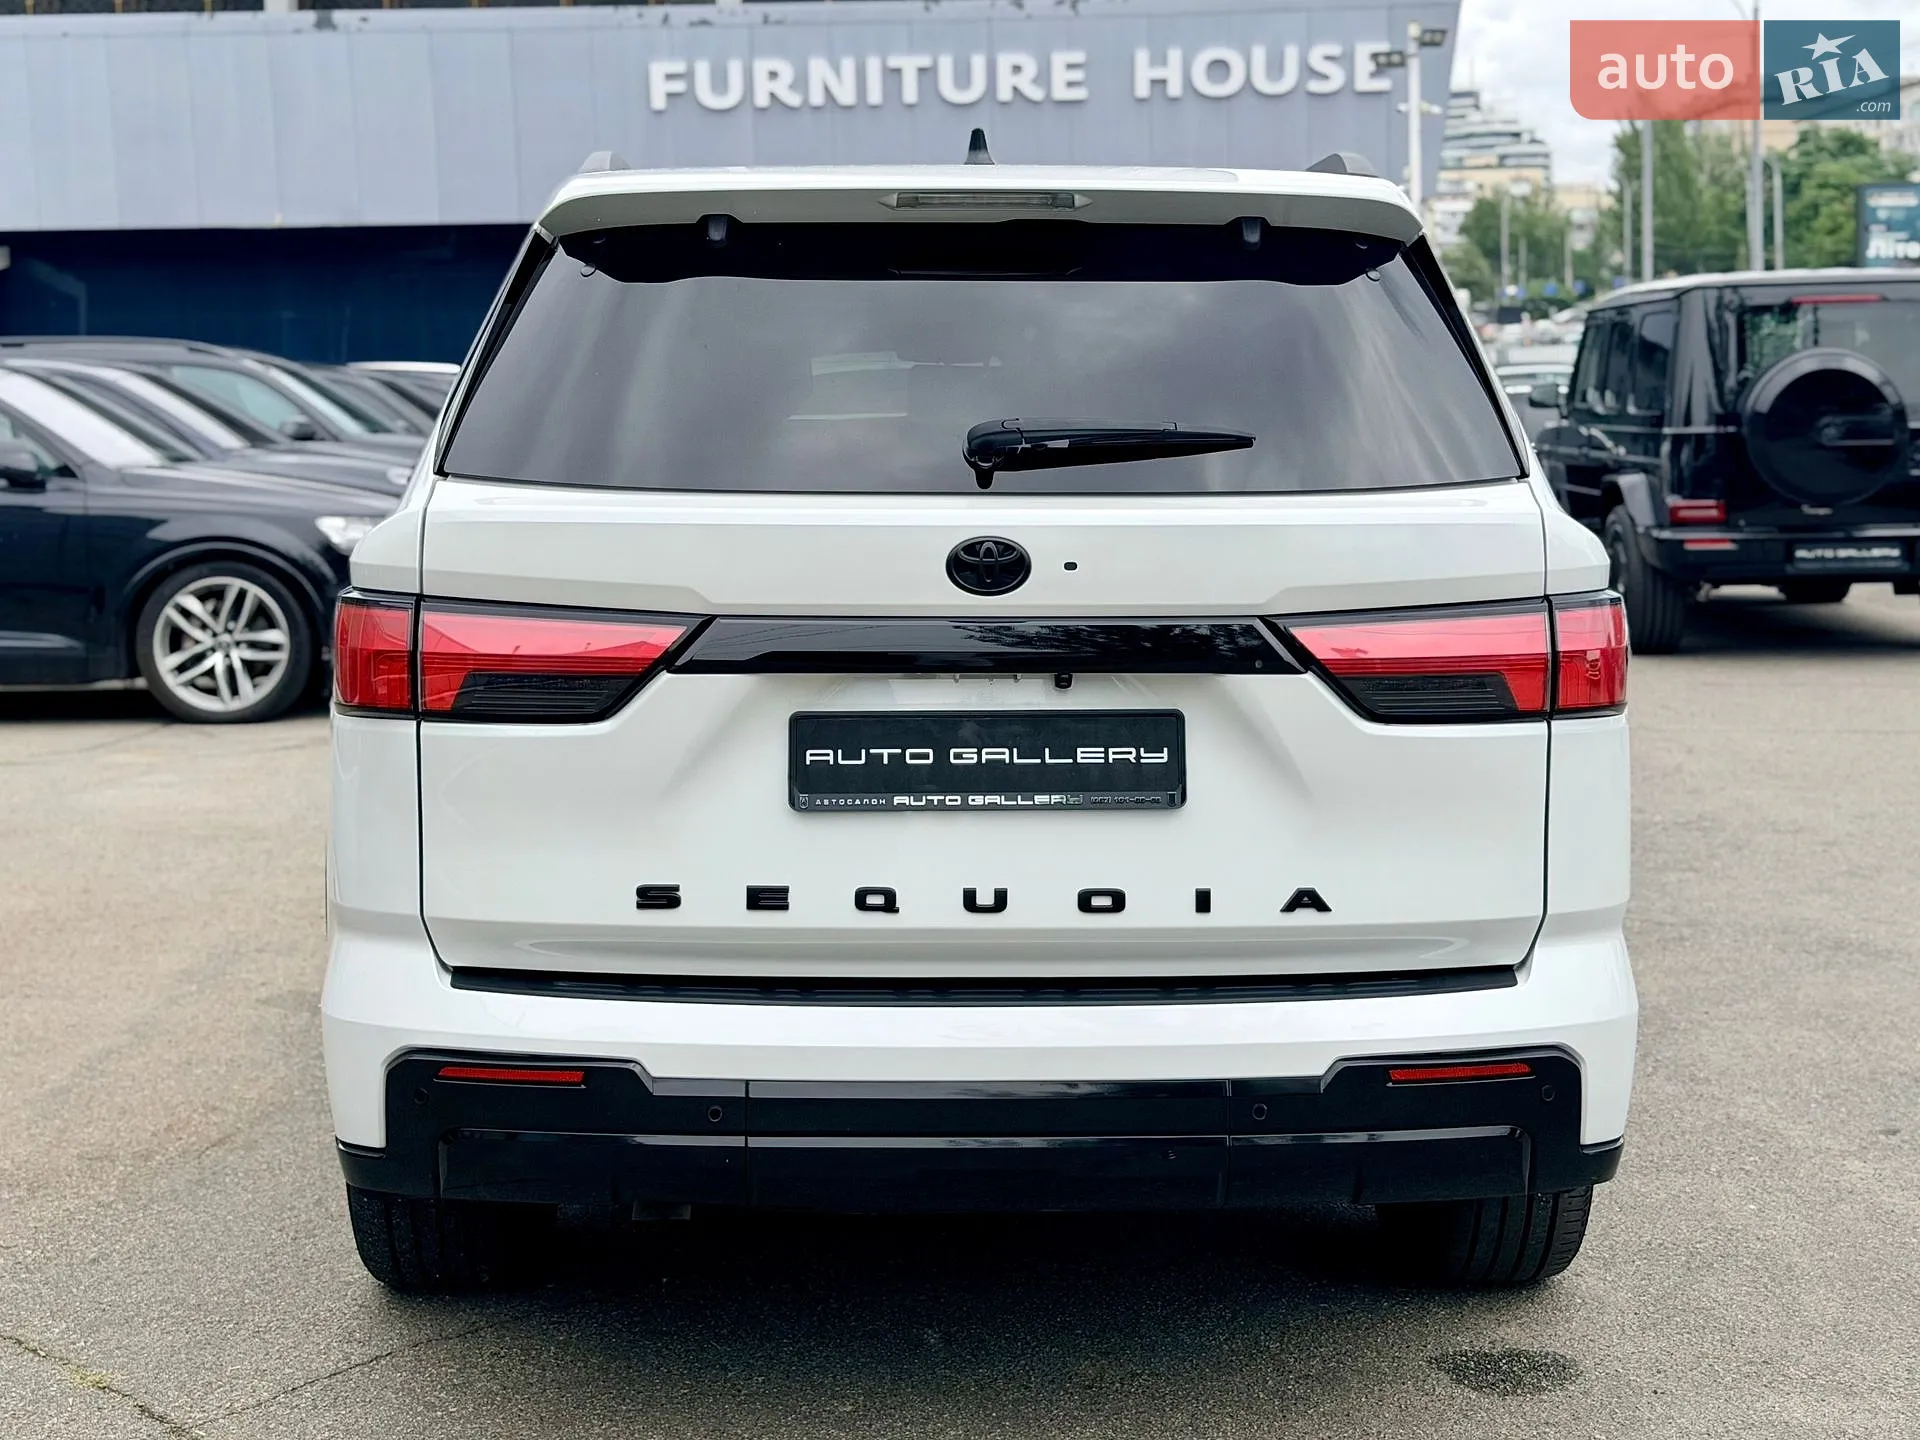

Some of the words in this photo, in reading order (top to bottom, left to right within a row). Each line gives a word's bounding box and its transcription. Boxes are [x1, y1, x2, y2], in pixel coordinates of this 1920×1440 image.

[648, 50, 1089, 111] FURNITURE
[1133, 41, 1393, 100] HOUSE
[805, 748, 934, 765] AUTO
[949, 747, 1168, 764] GALLERY
[893, 795, 962, 806] AUTO
[967, 794, 1083, 805] GALLERY
[635, 884, 1332, 913] SEQUOIA
